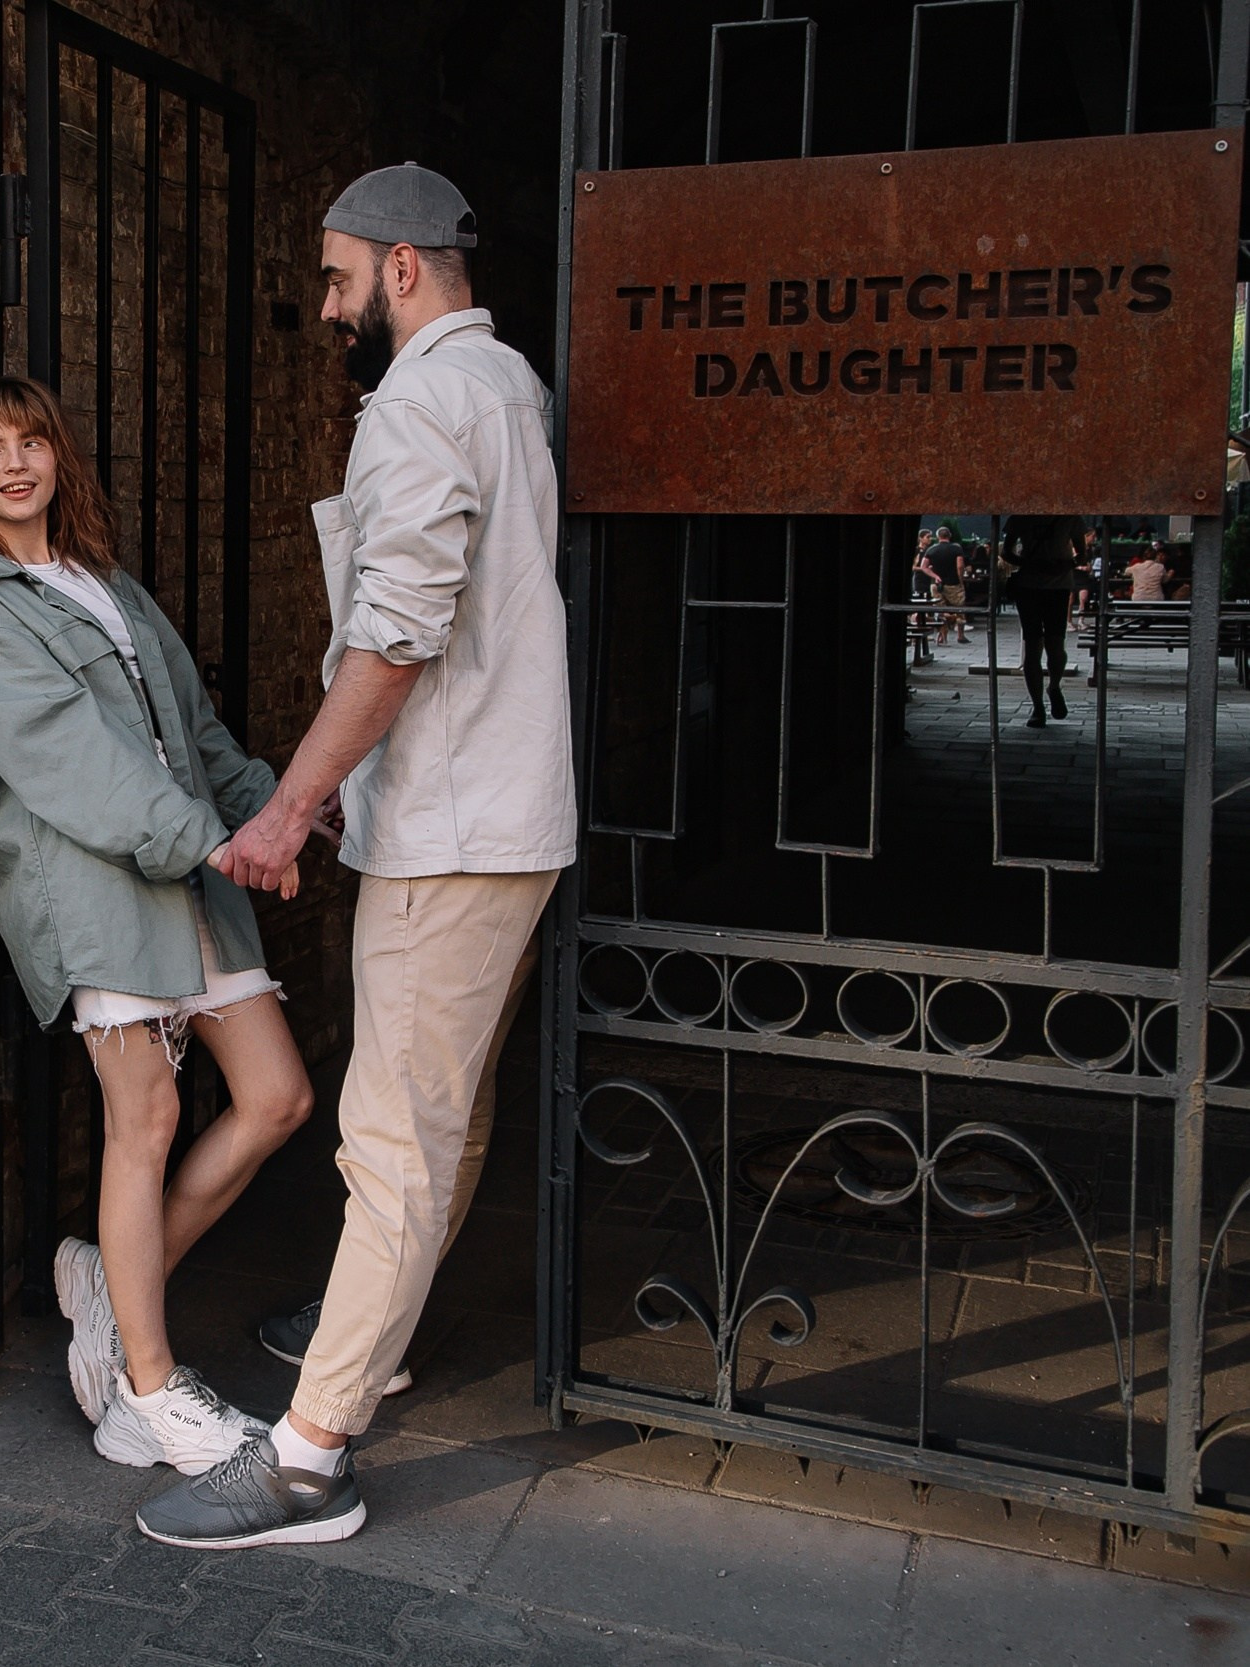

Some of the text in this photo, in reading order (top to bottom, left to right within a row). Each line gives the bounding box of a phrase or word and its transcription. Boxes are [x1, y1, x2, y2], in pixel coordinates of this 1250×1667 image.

[616, 264, 1173, 331] THE BUTCHER'S
[694, 343, 1079, 398] DAUGHTER
[110, 1337, 119, 1357] YEAH
[170, 1409, 203, 1429] OH YEAH
